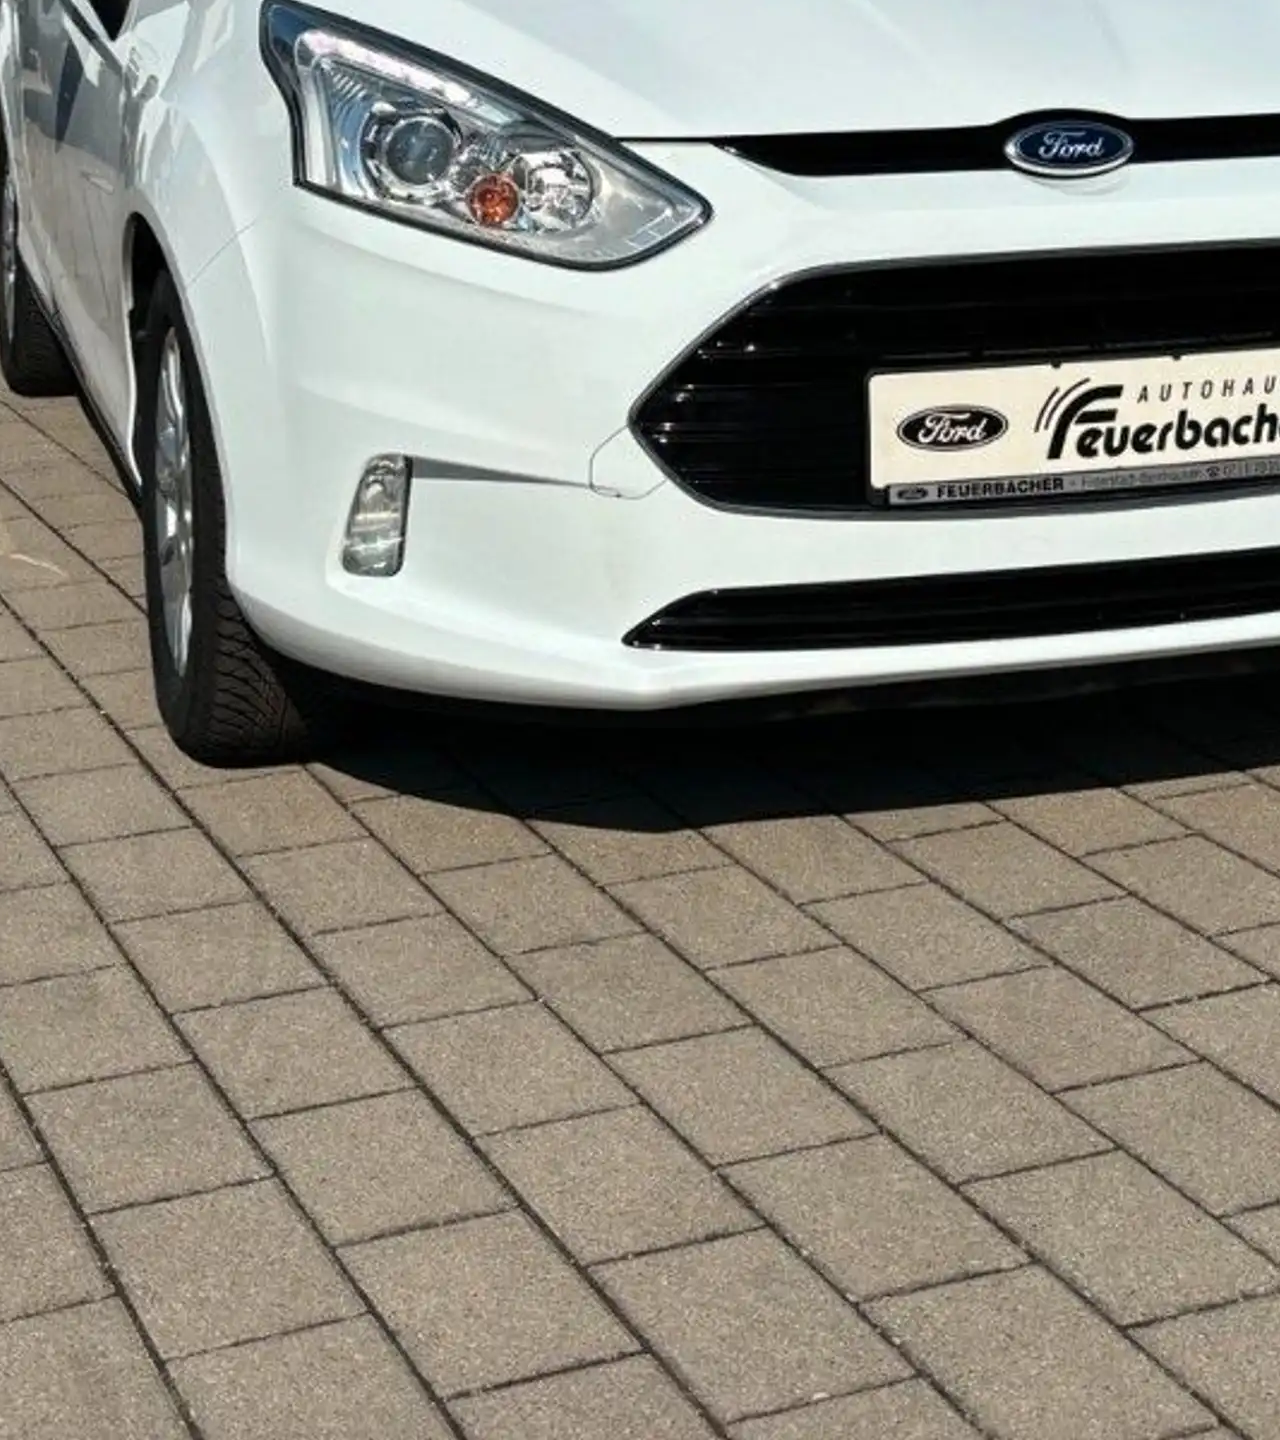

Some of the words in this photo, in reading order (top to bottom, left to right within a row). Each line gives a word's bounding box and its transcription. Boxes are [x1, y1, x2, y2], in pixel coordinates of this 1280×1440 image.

[1038, 129, 1105, 159] Ford
[917, 411, 989, 444] Ford
[936, 477, 1065, 499] FEUERBACHER
